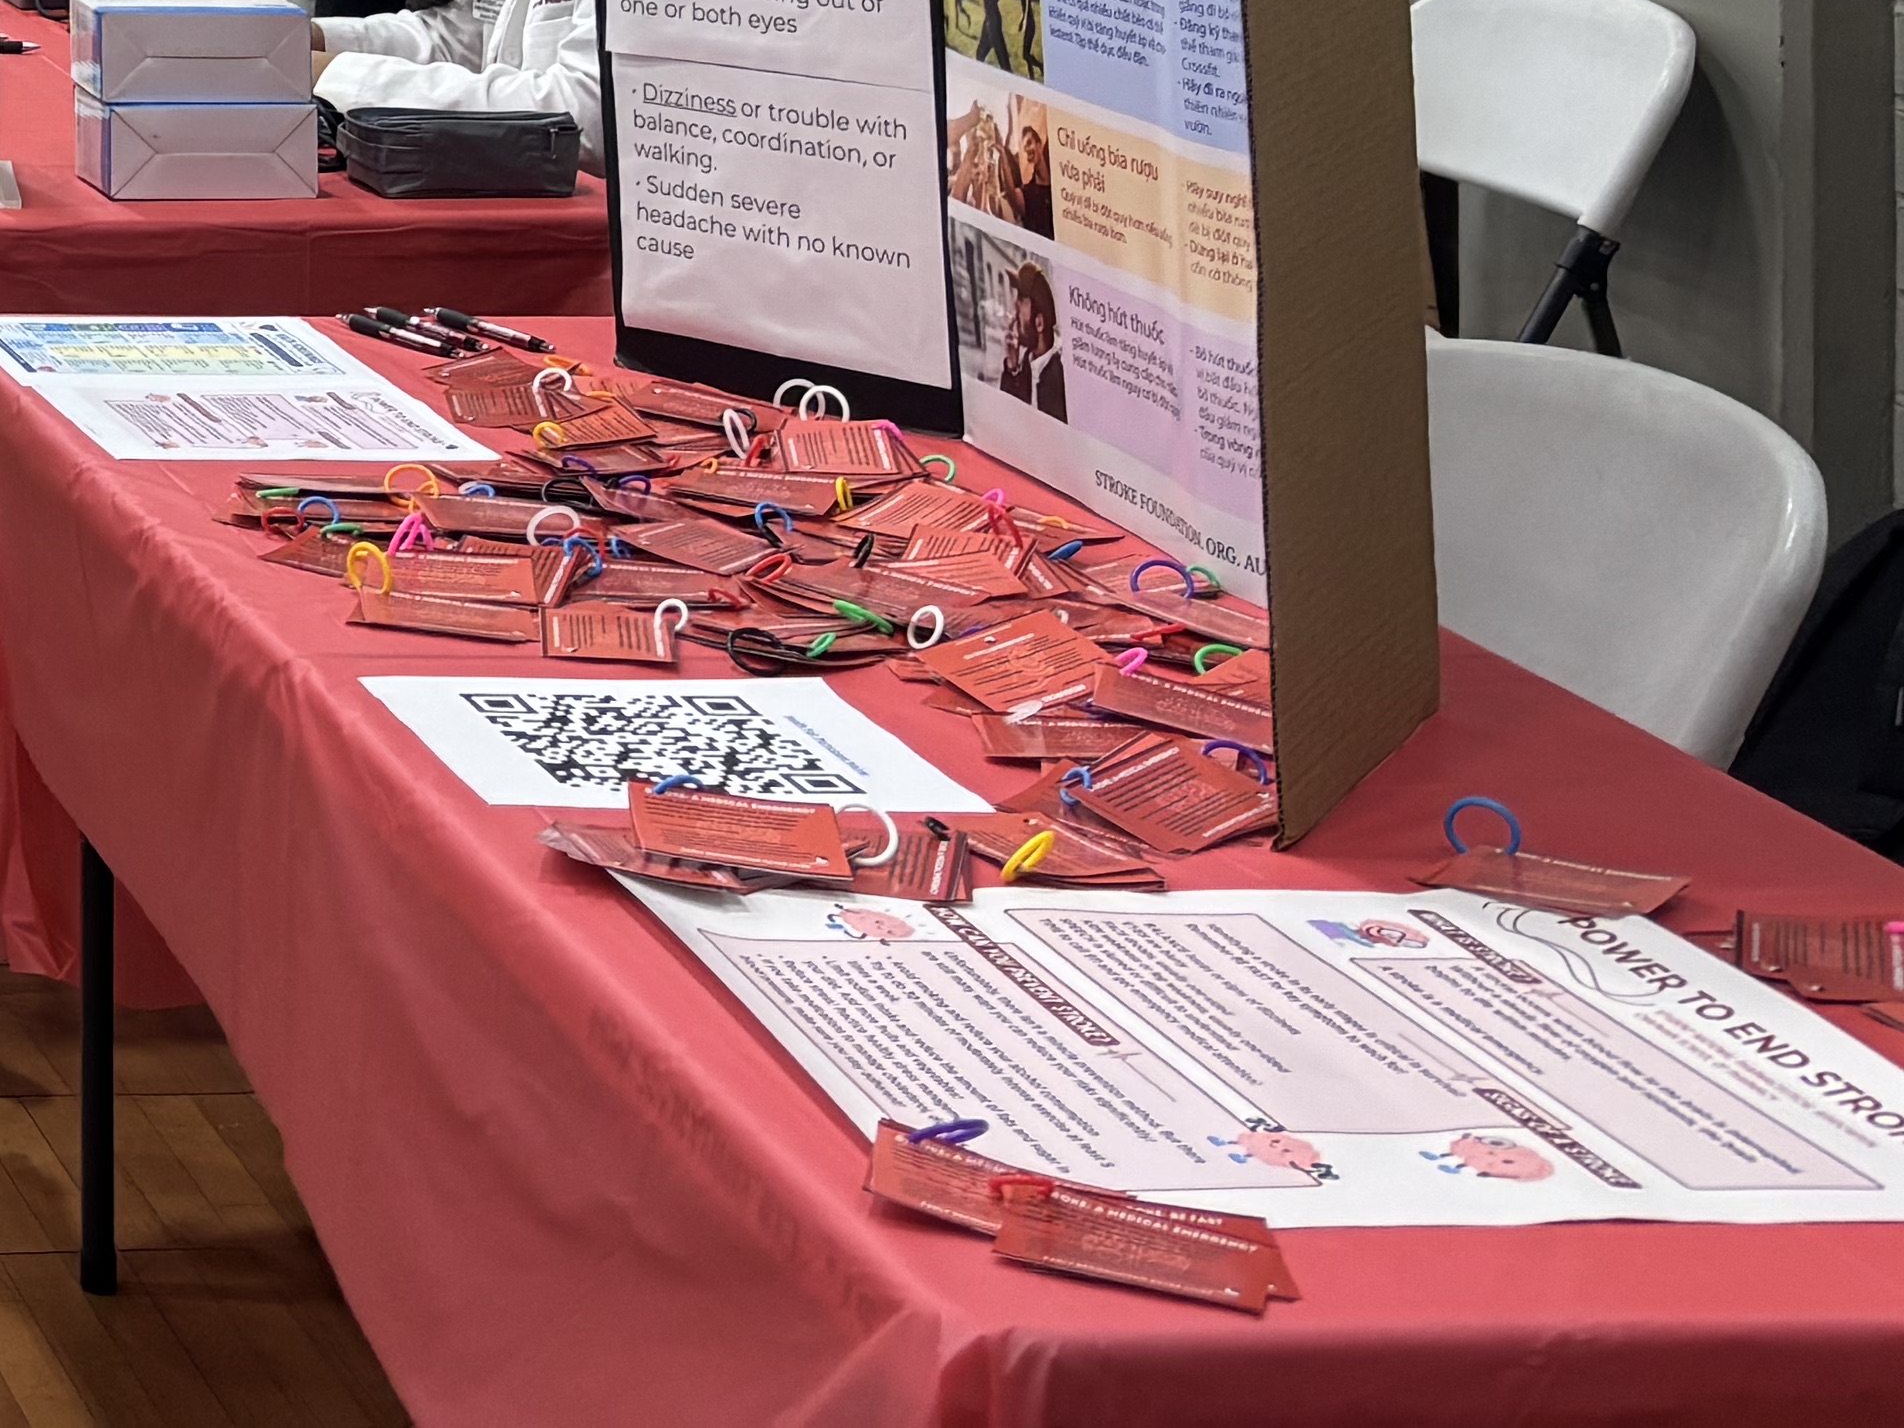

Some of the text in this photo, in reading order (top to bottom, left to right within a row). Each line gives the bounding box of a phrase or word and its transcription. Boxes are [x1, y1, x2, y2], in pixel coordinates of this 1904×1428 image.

[665, 3, 686, 19] or
[692, 2, 741, 27] both
[748, 14, 797, 34] eyes
[634, 109, 896, 168] balance, coordination, or
[643, 82, 906, 140] Dizziness or trouble with
[634, 142, 717, 174] walking.
[1108, 145, 1127, 170] bia
[647, 175, 801, 219] Sudden severe
[637, 201, 910, 269] headache with no known
[637, 236, 694, 259] cause
[1069, 285, 1106, 323] Không
[1130, 314, 1165, 345] thuốc
[1095, 470, 1138, 505] STROKE
[1206, 537, 1241, 567] ORG.
[1558, 916, 1688, 992] POWER
[1677, 990, 1735, 1021] TO
[1724, 1022, 1810, 1069] END
[1801, 1071, 1904, 1137] STRO
